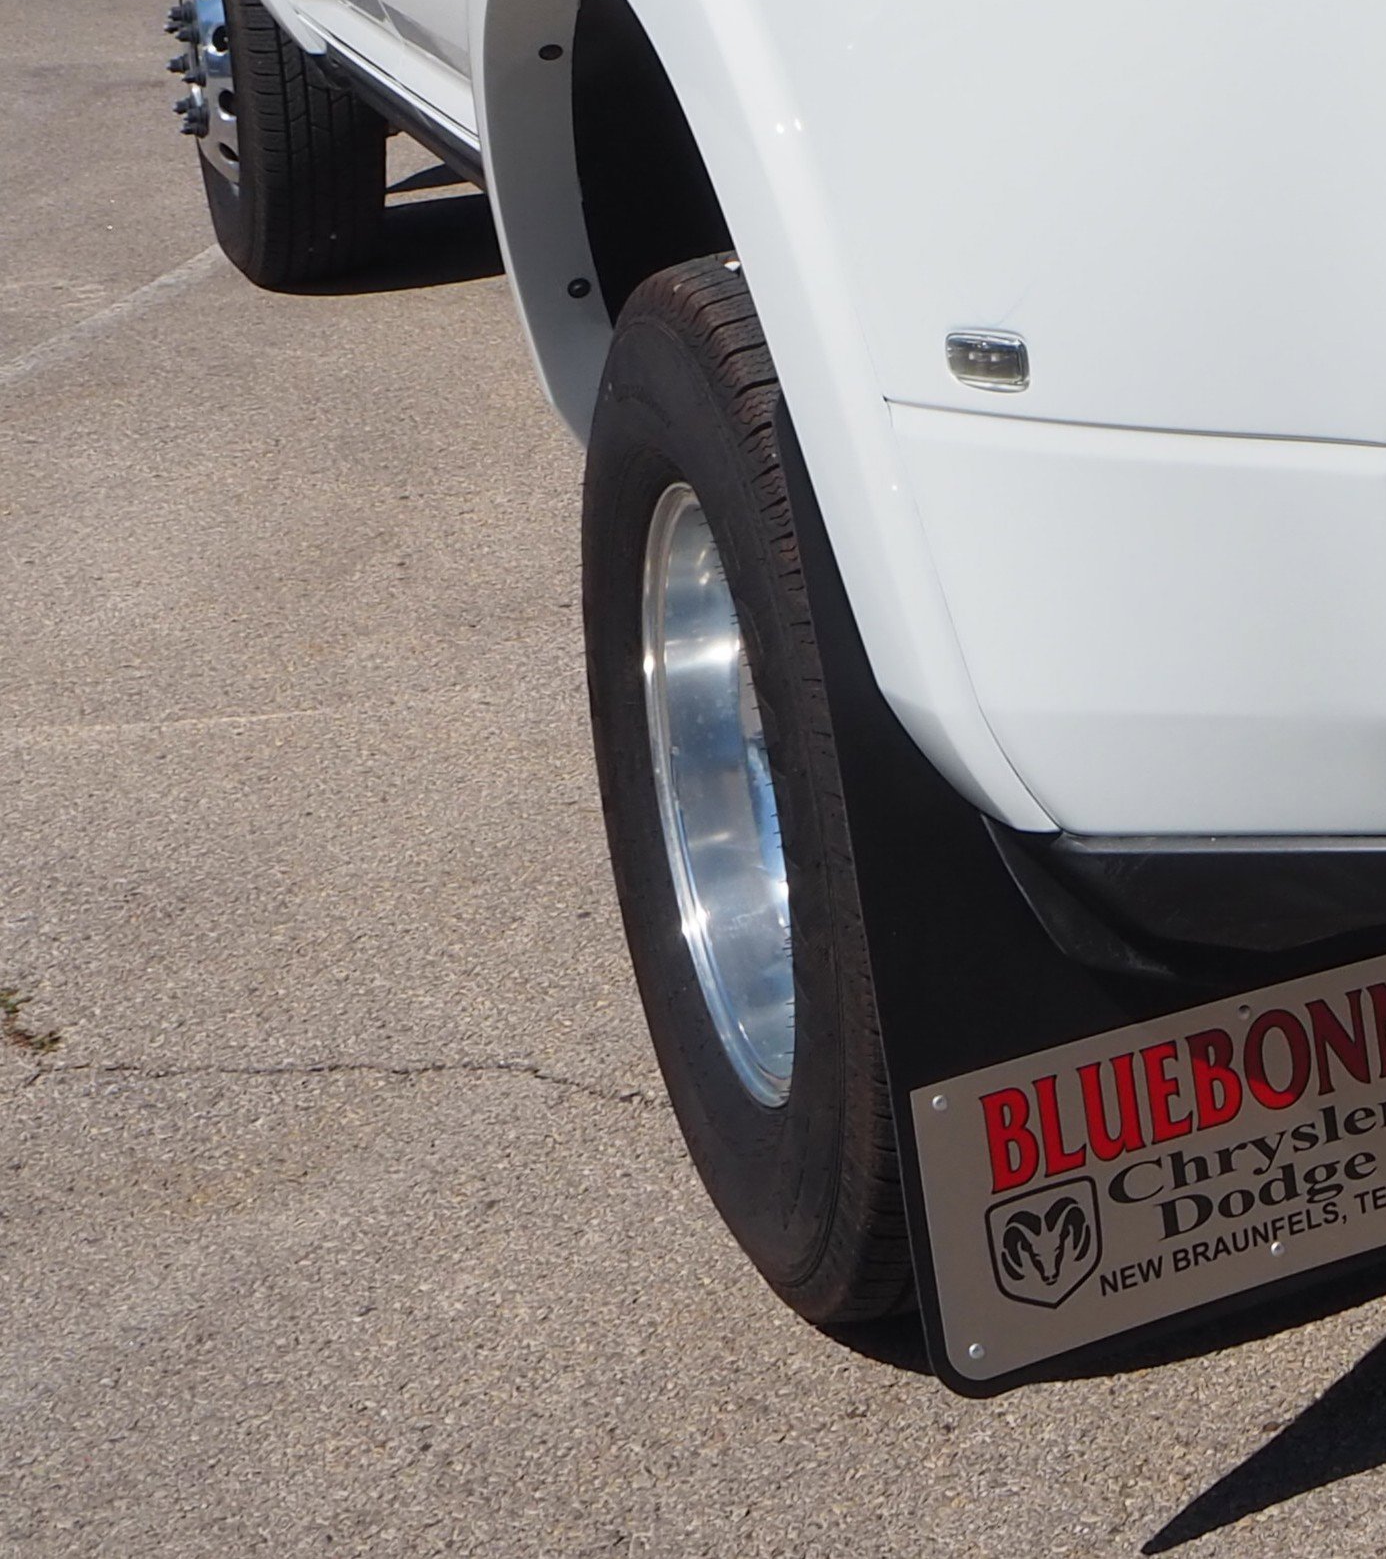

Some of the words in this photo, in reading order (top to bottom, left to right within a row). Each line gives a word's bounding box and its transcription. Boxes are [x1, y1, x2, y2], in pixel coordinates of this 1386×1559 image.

[1153, 1150, 1377, 1240] Dodge
[1099, 1255, 1164, 1296] NEW
[1172, 1201, 1348, 1273] BRAUNFELS,
